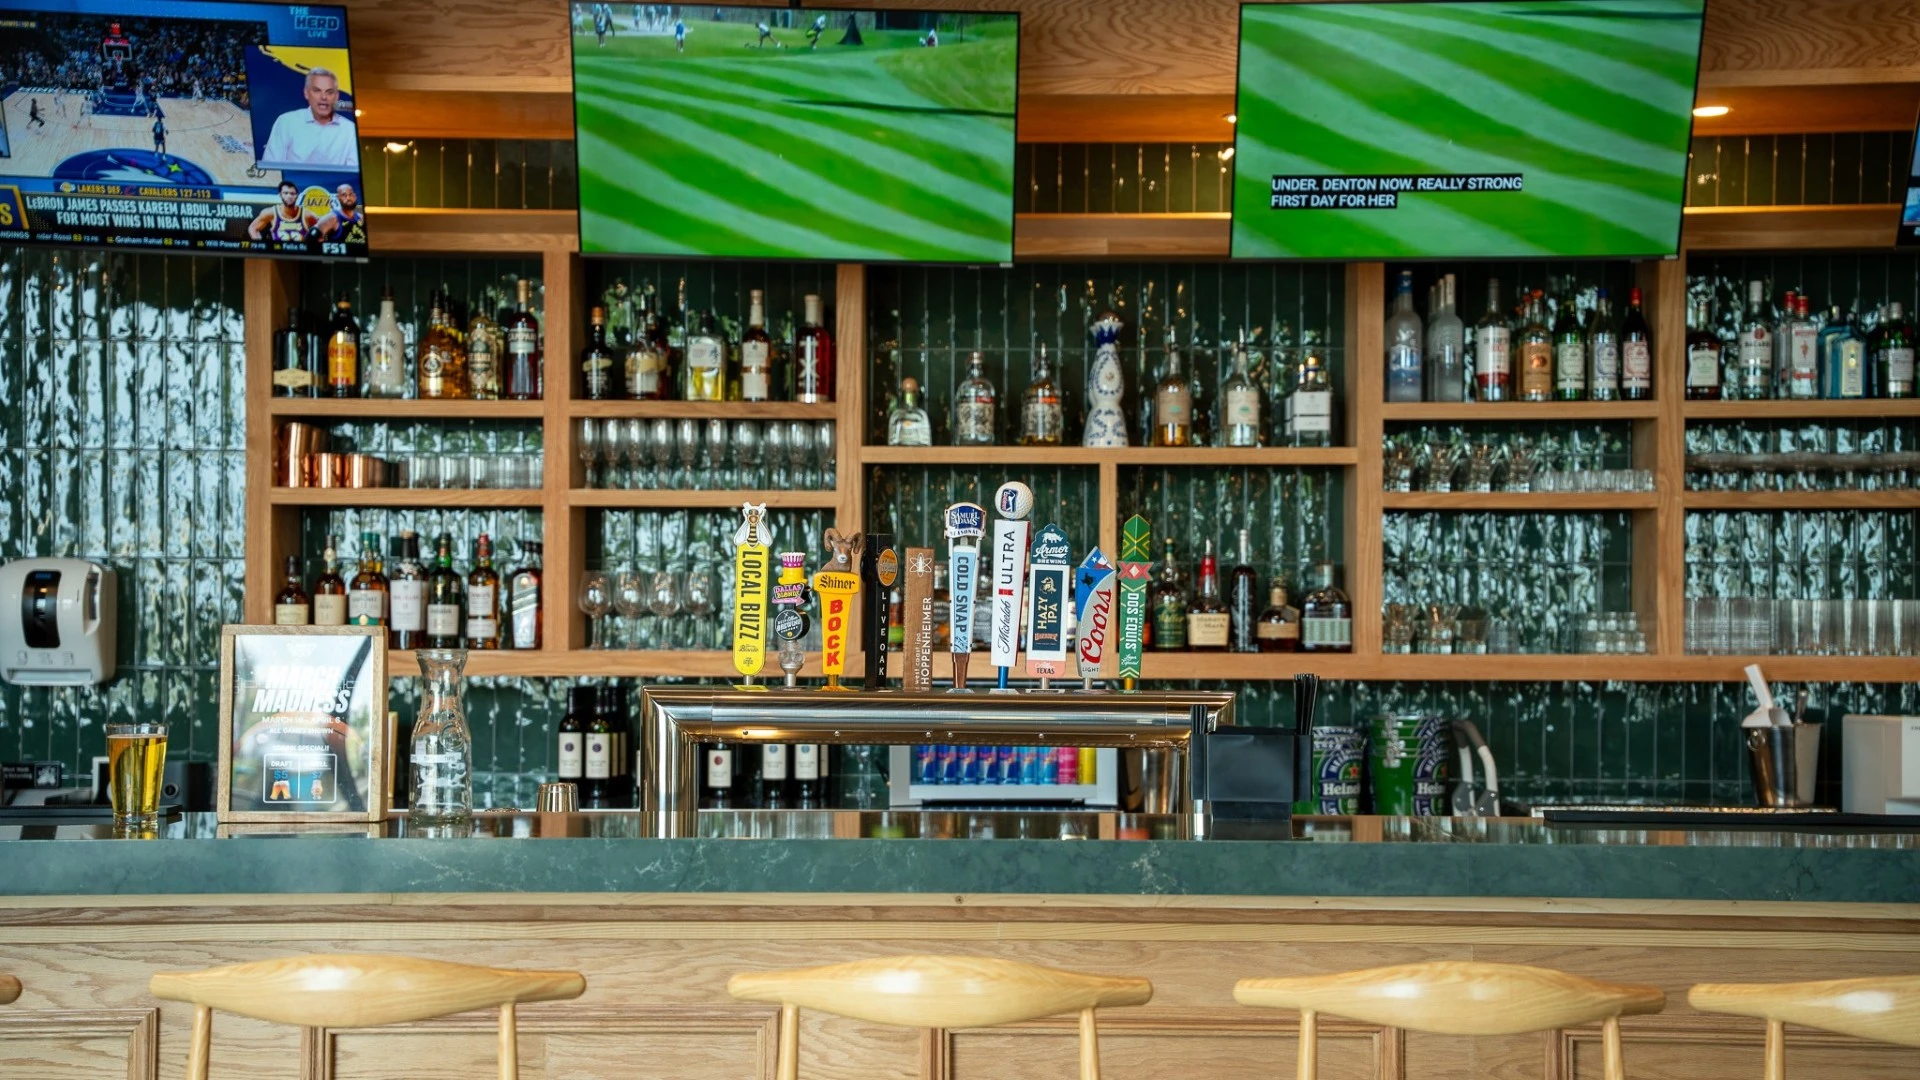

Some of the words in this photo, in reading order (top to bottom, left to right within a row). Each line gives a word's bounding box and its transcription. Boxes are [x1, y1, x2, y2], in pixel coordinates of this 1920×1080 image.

[289, 6, 309, 16] THE
[294, 15, 340, 31] HERD
[307, 30, 328, 38] LIVE
[77, 184, 106, 194] LAKERS
[139, 186, 178, 197] CAVALIERS
[179, 188, 212, 198] 127-113
[1271, 177, 1320, 191] UNDER.
[1322, 178, 1377, 191] DENTON
[1379, 177, 1414, 190] NOW.
[1417, 177, 1465, 190] REALLY
[1467, 176, 1523, 190] STRONG
[66, 198, 98, 211] JAMES
[100, 199, 137, 213] PASSES
[138, 201, 178, 215] KAREEM
[180, 202, 254, 218] ABDUL-JABBAR
[1271, 194, 1308, 207] FIRST
[1310, 194, 1337, 206] DAY
[1339, 194, 1366, 206] FOR
[1367, 194, 1396, 206] HER
[56, 211, 79, 226] FOR
[80, 212, 111, 227] MOST
[111, 213, 141, 228] WINS
[142, 215, 155, 229] IN
[156, 216, 180, 230] NBA
[181, 217, 227, 232] HISTORY
[322, 242, 347, 254] FS1
[951, 508, 980, 520] SAMUEL
[952, 517, 978, 526] ADAMS
[1001, 530, 1015, 585] ULTRA
[1032, 543, 1069, 559] Armor
[740, 550, 763, 598] LOCAL
[818, 574, 856, 590] Shiner
[957, 556, 969, 591] COLD
[775, 584, 802, 594] DALLAS
[955, 594, 969, 633] SNAP
[1037, 596, 1048, 629] HAZY
[1047, 603, 1058, 623] IPA
[1126, 592, 1140, 615] DOS
[738, 602, 761, 640] BUZZ
[997, 599, 1012, 654] Michelob
[1081, 588, 1112, 664] Coors
[826, 599, 844, 667] BOCK
[920, 597, 932, 685] HOPPENHEIMER
[1124, 616, 1139, 650] EQUIS
[1036, 667, 1055, 675] TEXAS
[252, 689, 351, 713] MADNESS
